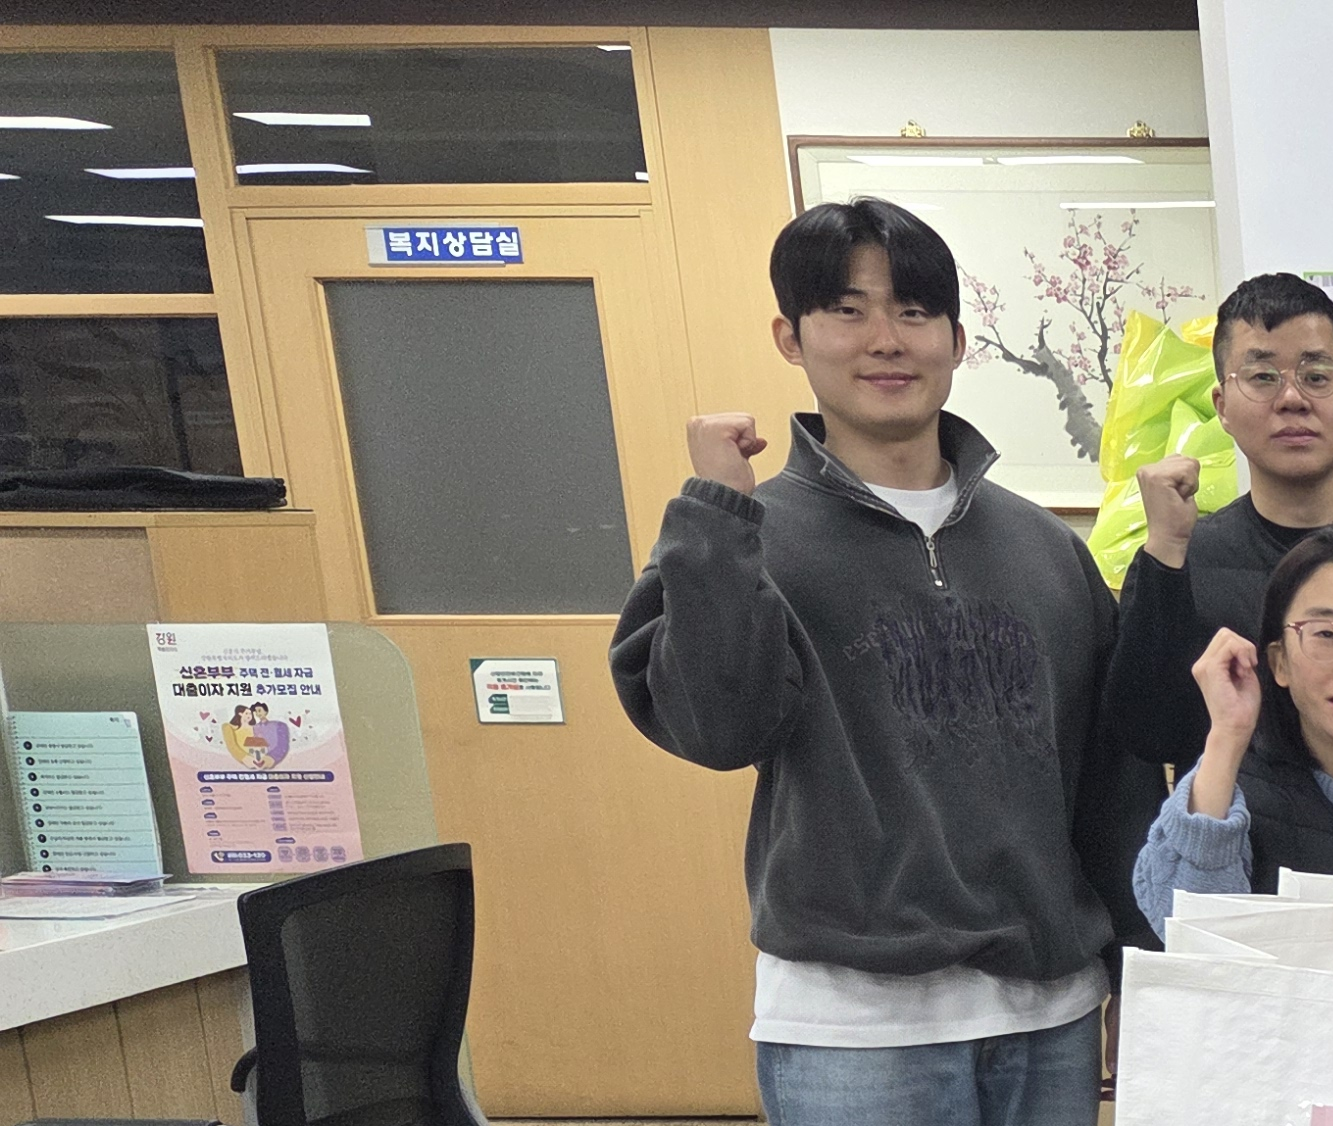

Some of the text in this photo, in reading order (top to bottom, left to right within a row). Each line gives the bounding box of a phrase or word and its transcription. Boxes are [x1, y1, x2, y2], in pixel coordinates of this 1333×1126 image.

[388, 231, 520, 258] 복지상담실
[172, 683, 224, 698] 대출이자
[227, 682, 253, 697] 지원
[300, 684, 322, 696] 안내
